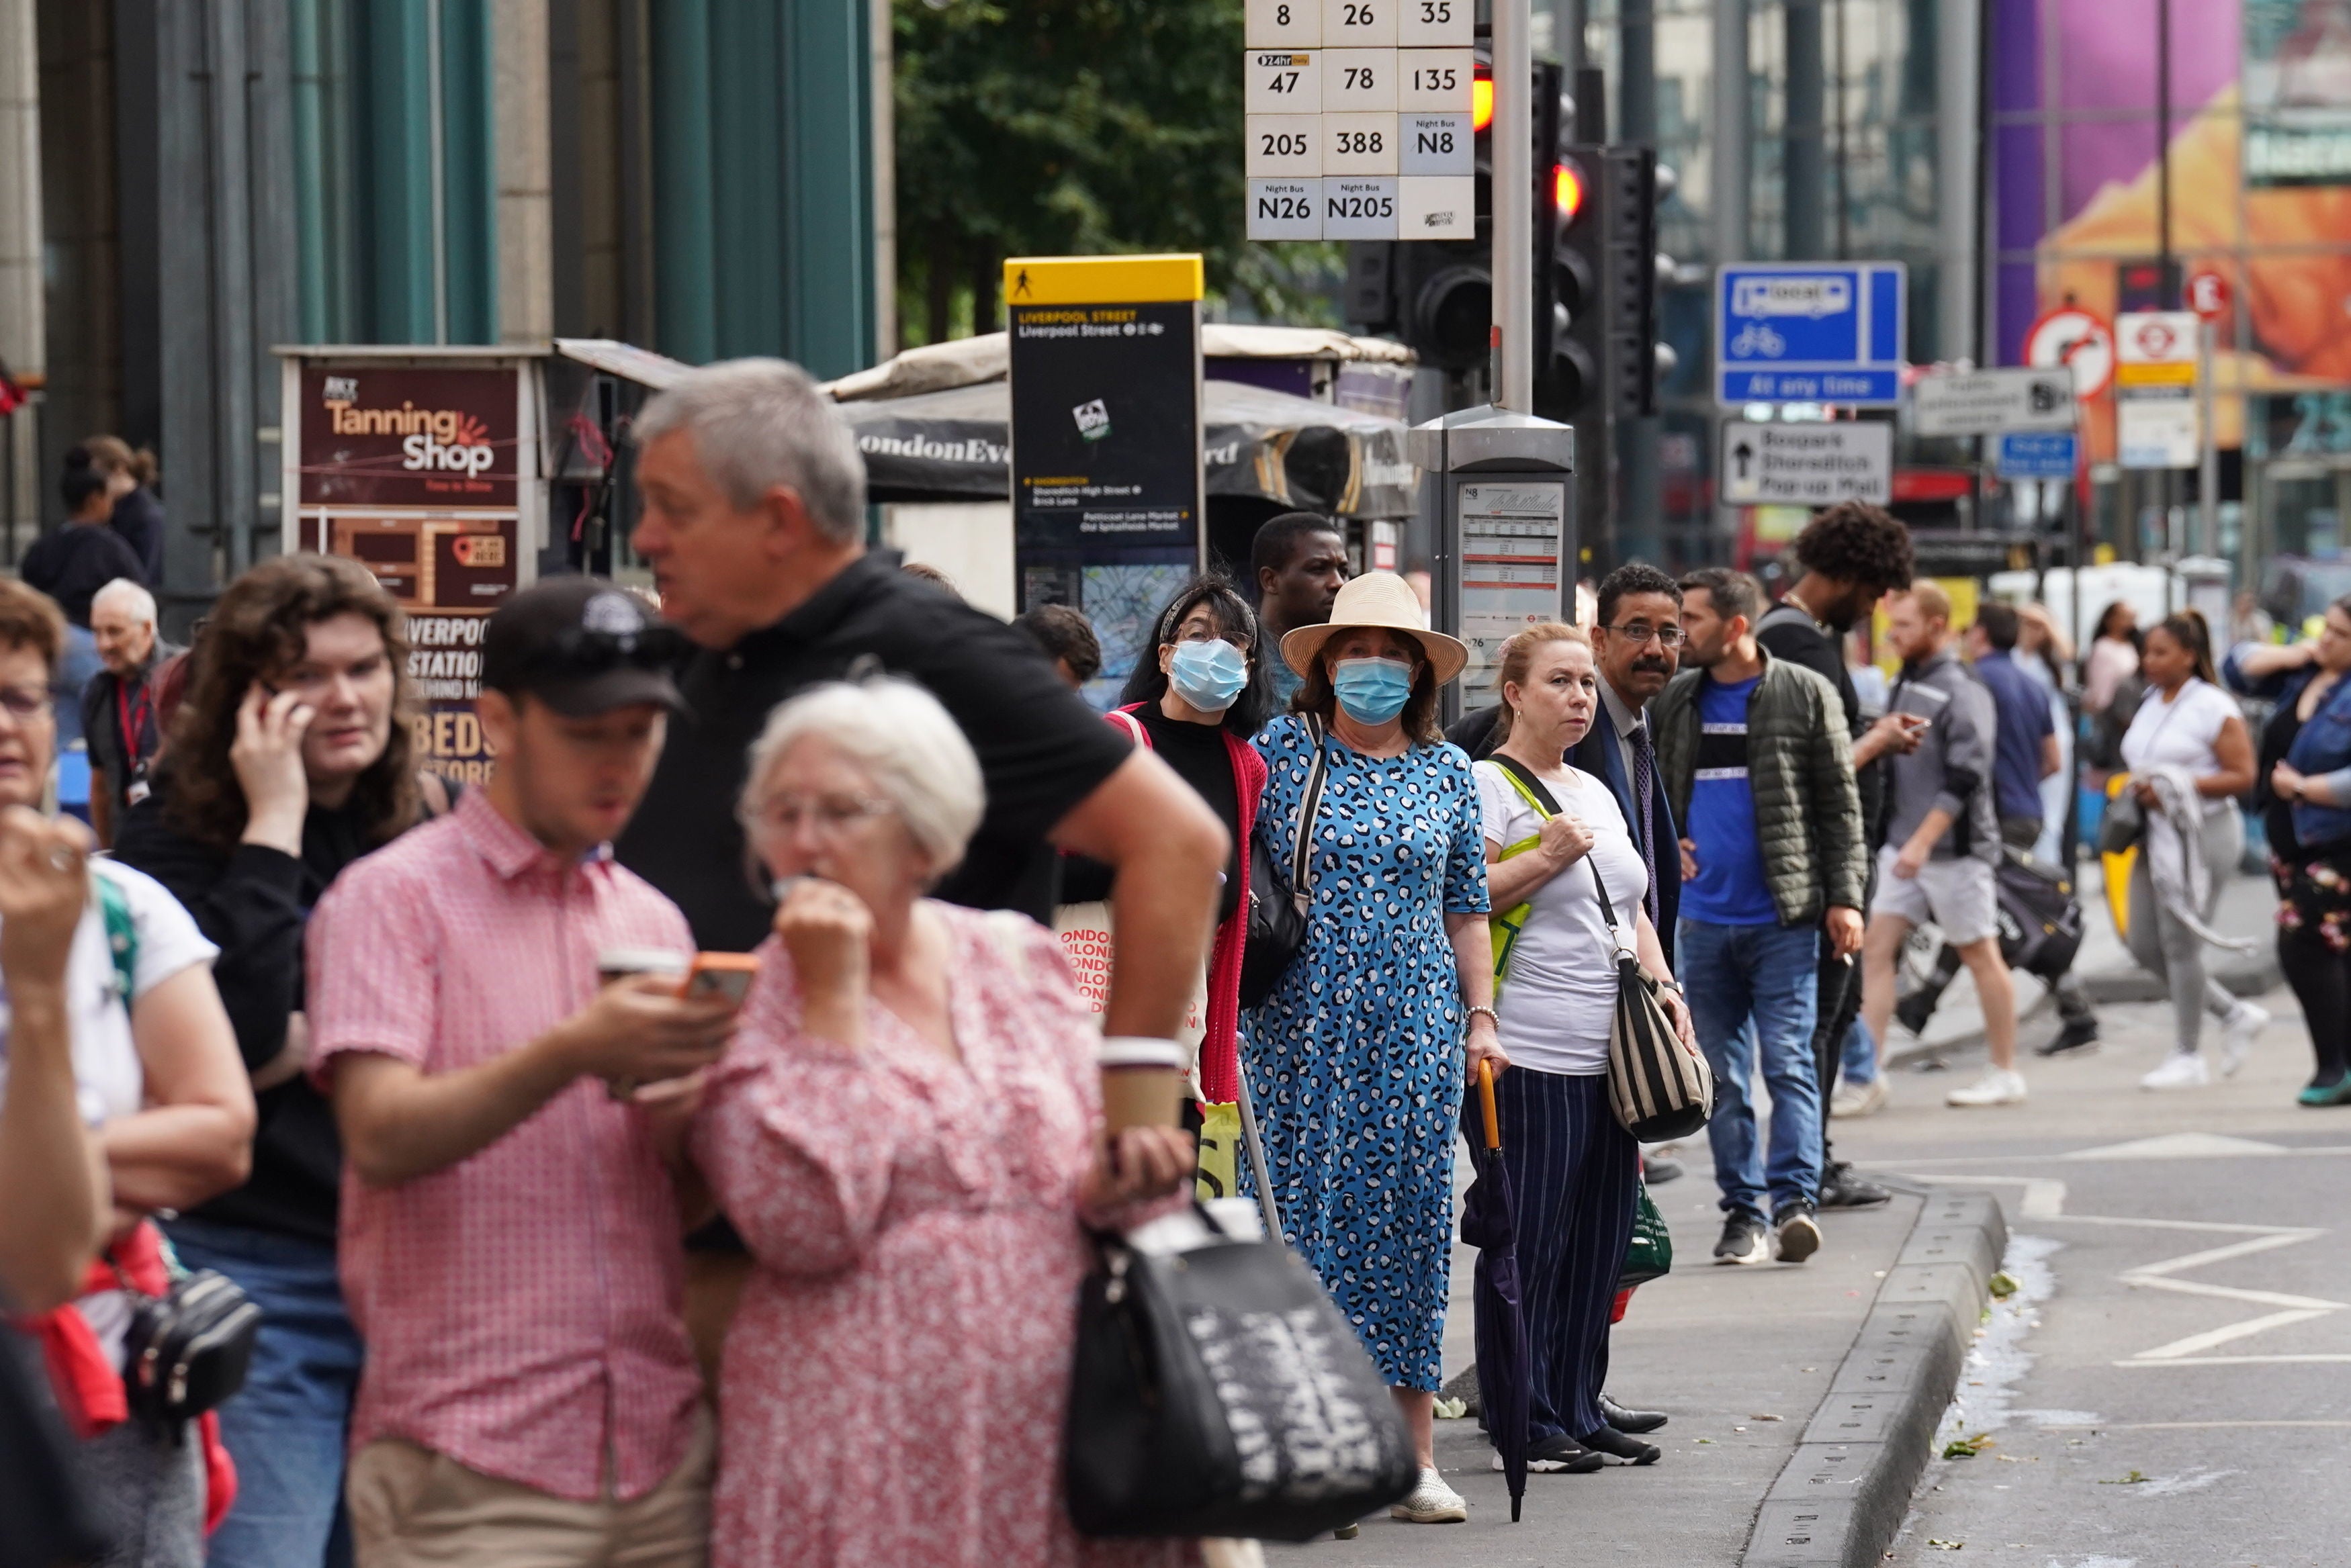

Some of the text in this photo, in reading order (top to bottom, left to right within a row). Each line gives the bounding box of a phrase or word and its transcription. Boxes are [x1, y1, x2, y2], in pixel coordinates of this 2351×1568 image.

[1277, 4, 1290, 26] 8
[1343, 4, 1374, 26] 26
[1421, 2, 1451, 23] 35
[1268, 56, 1291, 66] 24hr
[1268, 72, 1300, 93] 47
[1344, 68, 1374, 89] 78
[1414, 69, 1456, 90] 135
[1416, 120, 1437, 129] Night
[1262, 134, 1307, 155] 205
[1337, 132, 1383, 154] 388
[1418, 132, 1454, 154] N8
[1266, 185, 1287, 193] Night
[1341, 184, 1362, 192] Night
[1259, 197, 1311, 219] N26
[1328, 197, 1392, 218] N205
[1018, 310, 1137, 324] LIVERPOOL STREET
[1018, 323, 1120, 338] Liverpool Street
[1748, 373, 1871, 400] At any time
[324, 400, 459, 445] Tanning
[402, 432, 494, 479] Shop
[1032, 496, 1079, 506] Brick Lane
[1033, 485, 1131, 498] Shoreditch High Street
[1465, 488, 1478, 497] N8
[1083, 510, 1179, 522] Petticoat Lane Market
[1147, 520, 1180, 532] Market
[1465, 638, 1484, 647] N26
[1061, 929, 1116, 945] ONDO
